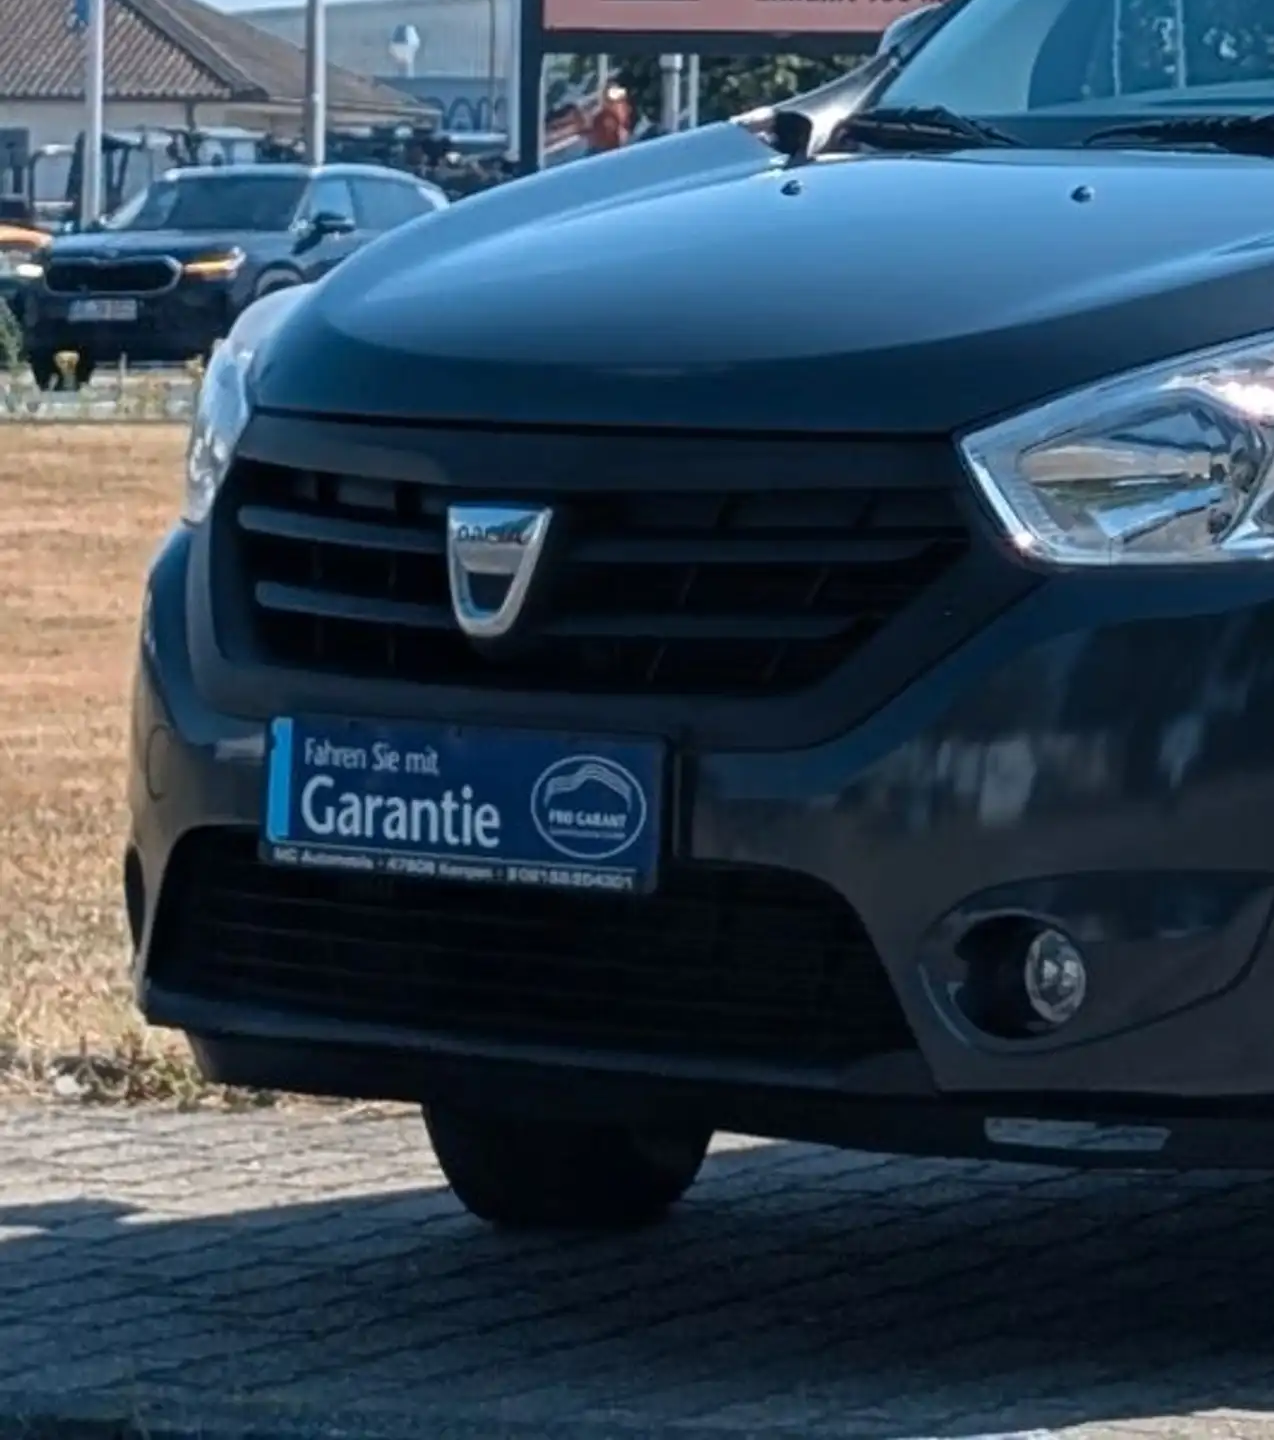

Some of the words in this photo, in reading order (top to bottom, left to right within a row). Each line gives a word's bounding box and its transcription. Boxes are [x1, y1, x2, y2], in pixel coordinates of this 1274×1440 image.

[304, 737, 367, 769] Fahren
[371, 741, 399, 772] Sie
[405, 744, 440, 776] mit
[301, 773, 501, 848] Garantie
